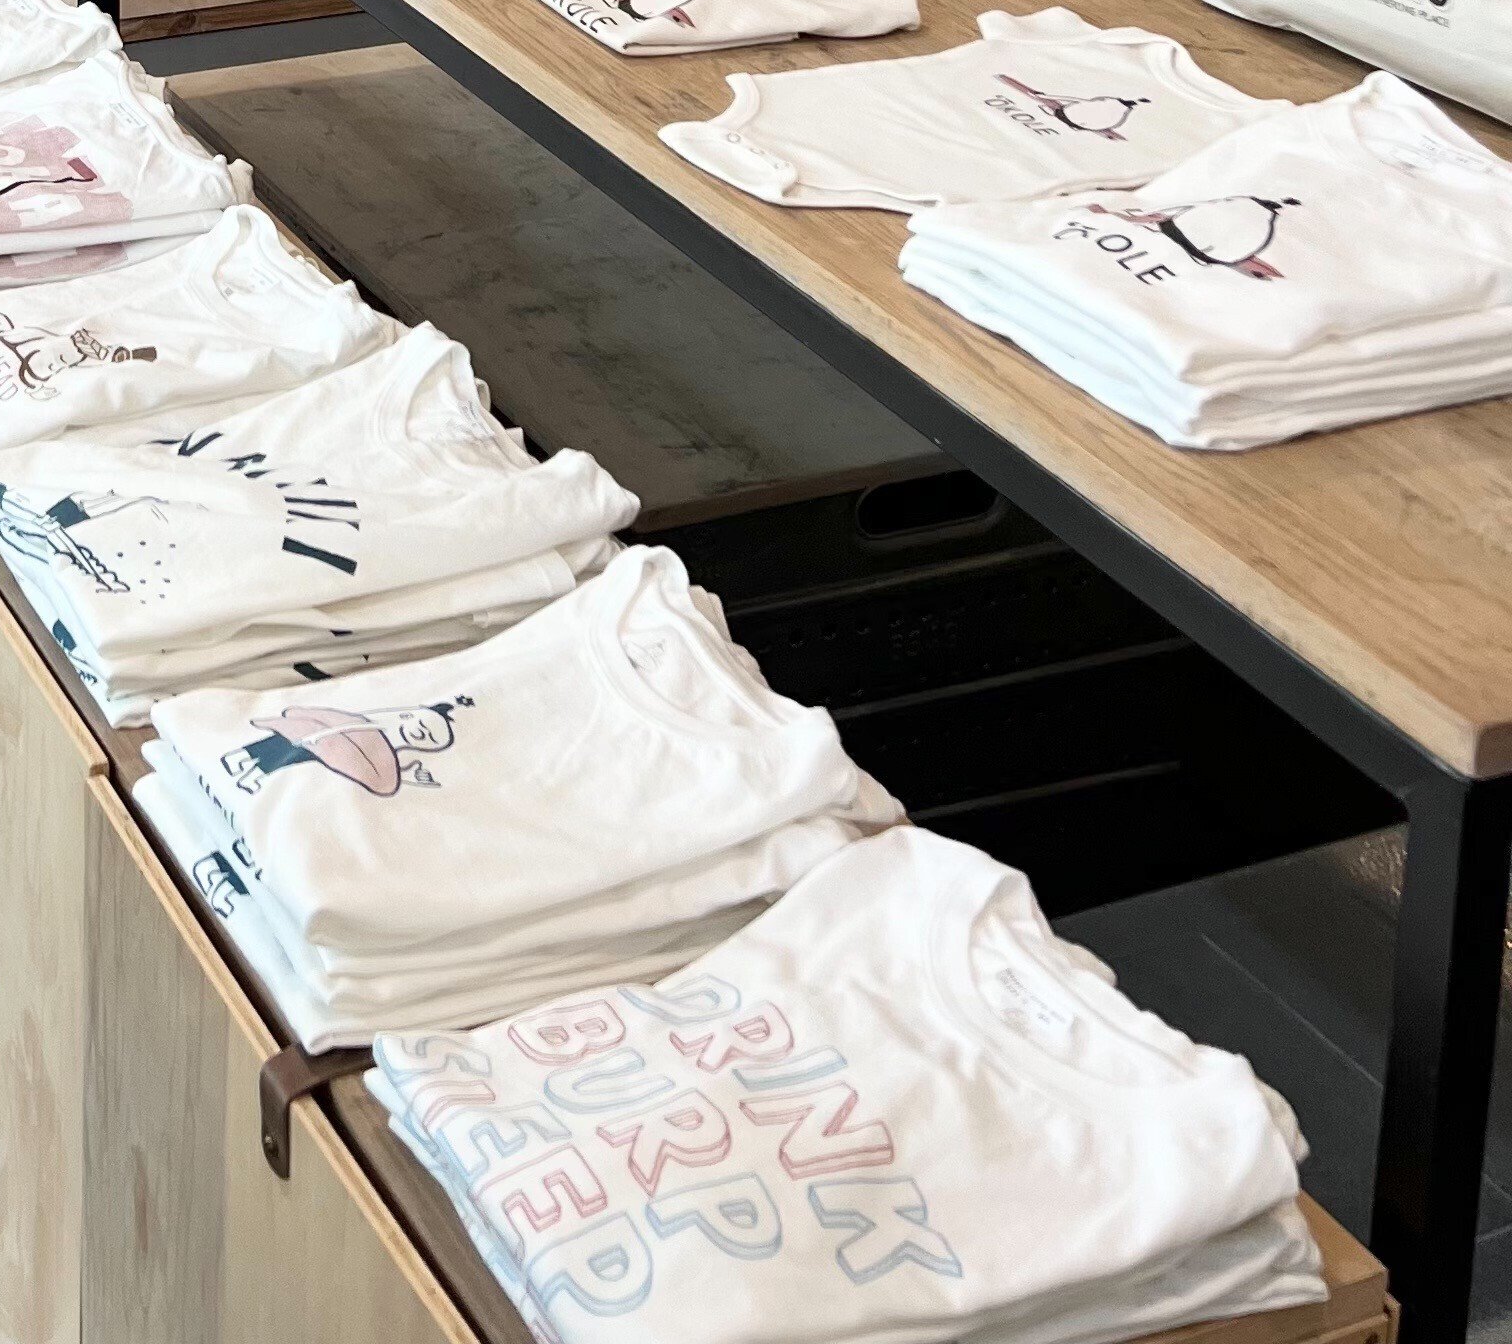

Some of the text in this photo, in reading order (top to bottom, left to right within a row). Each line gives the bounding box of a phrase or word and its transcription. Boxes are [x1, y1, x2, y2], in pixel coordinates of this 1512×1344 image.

[374, 1030, 655, 1317] SLEEP
[506, 998, 785, 1260] BURP
[614, 972, 965, 1286] DRINK
